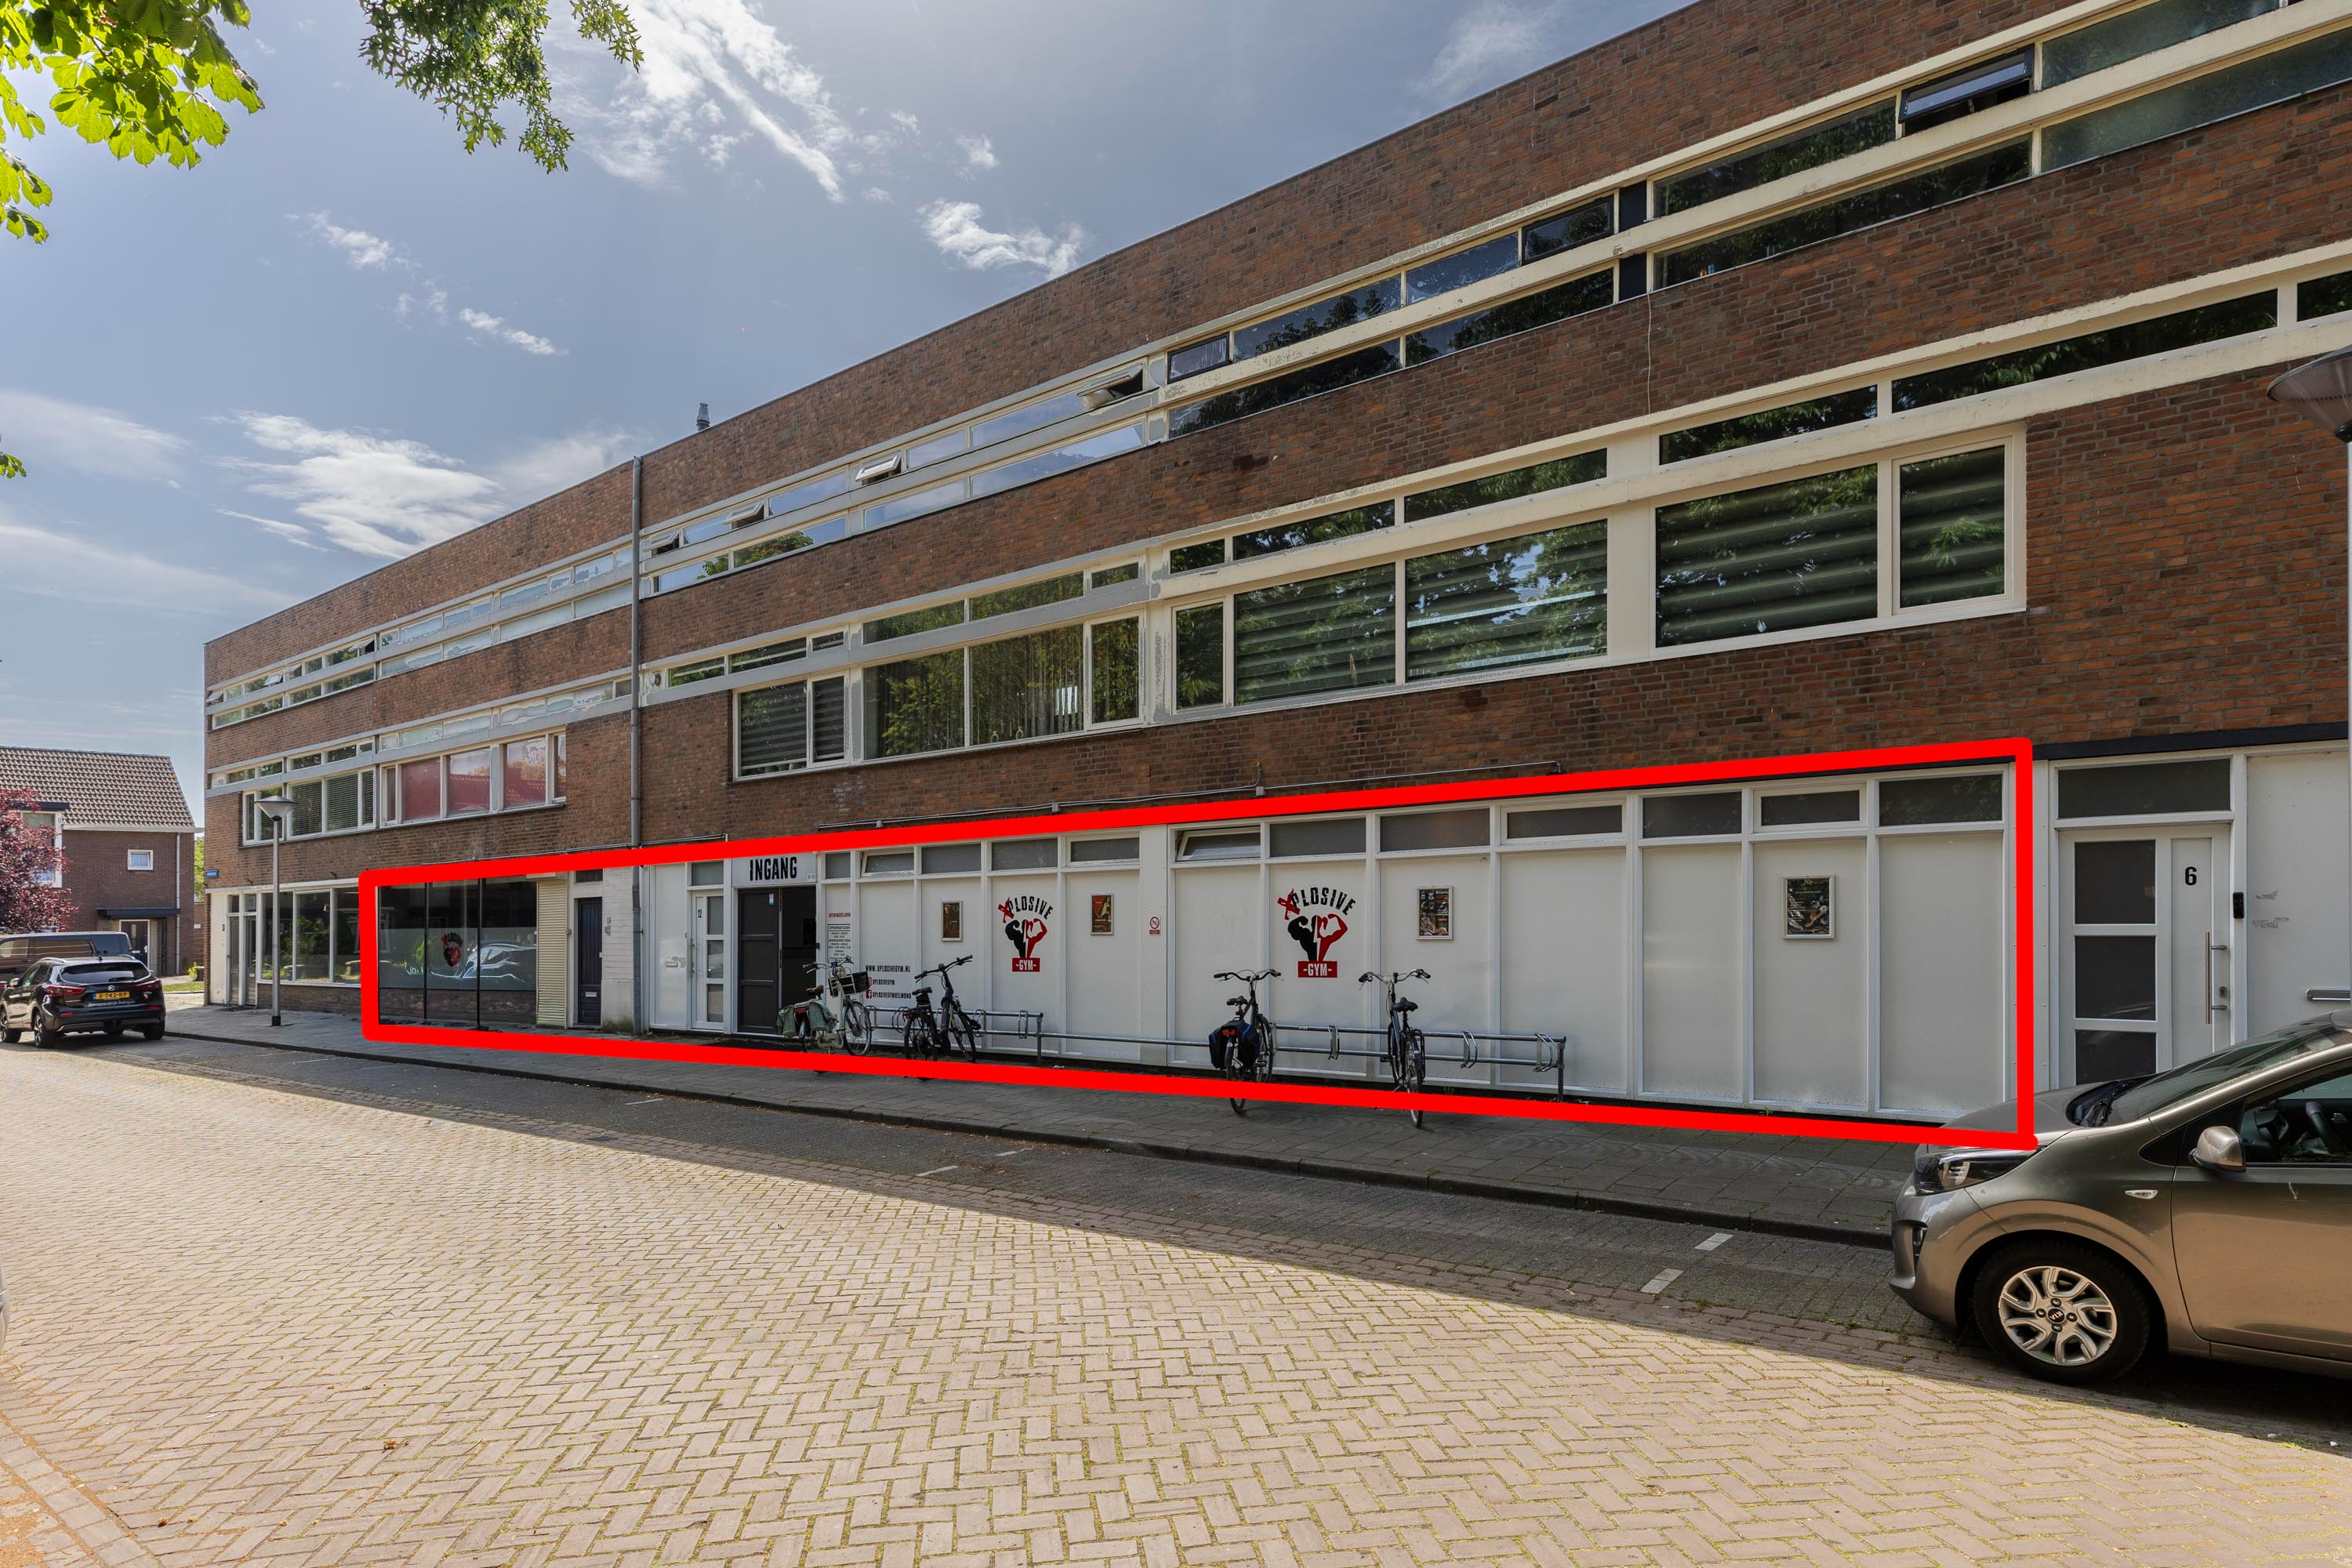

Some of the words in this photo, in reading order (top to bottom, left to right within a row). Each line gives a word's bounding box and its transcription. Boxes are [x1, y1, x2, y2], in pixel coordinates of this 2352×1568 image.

[750, 857, 797, 881] INGANG
[2184, 866, 2198, 886] 6
[697, 909, 702, 918] 12
[997, 896, 1054, 924] XPLOSIVE
[1276, 887, 1356, 920] XPLOSIVE
[2049, 1311, 2063, 1320] KIA
